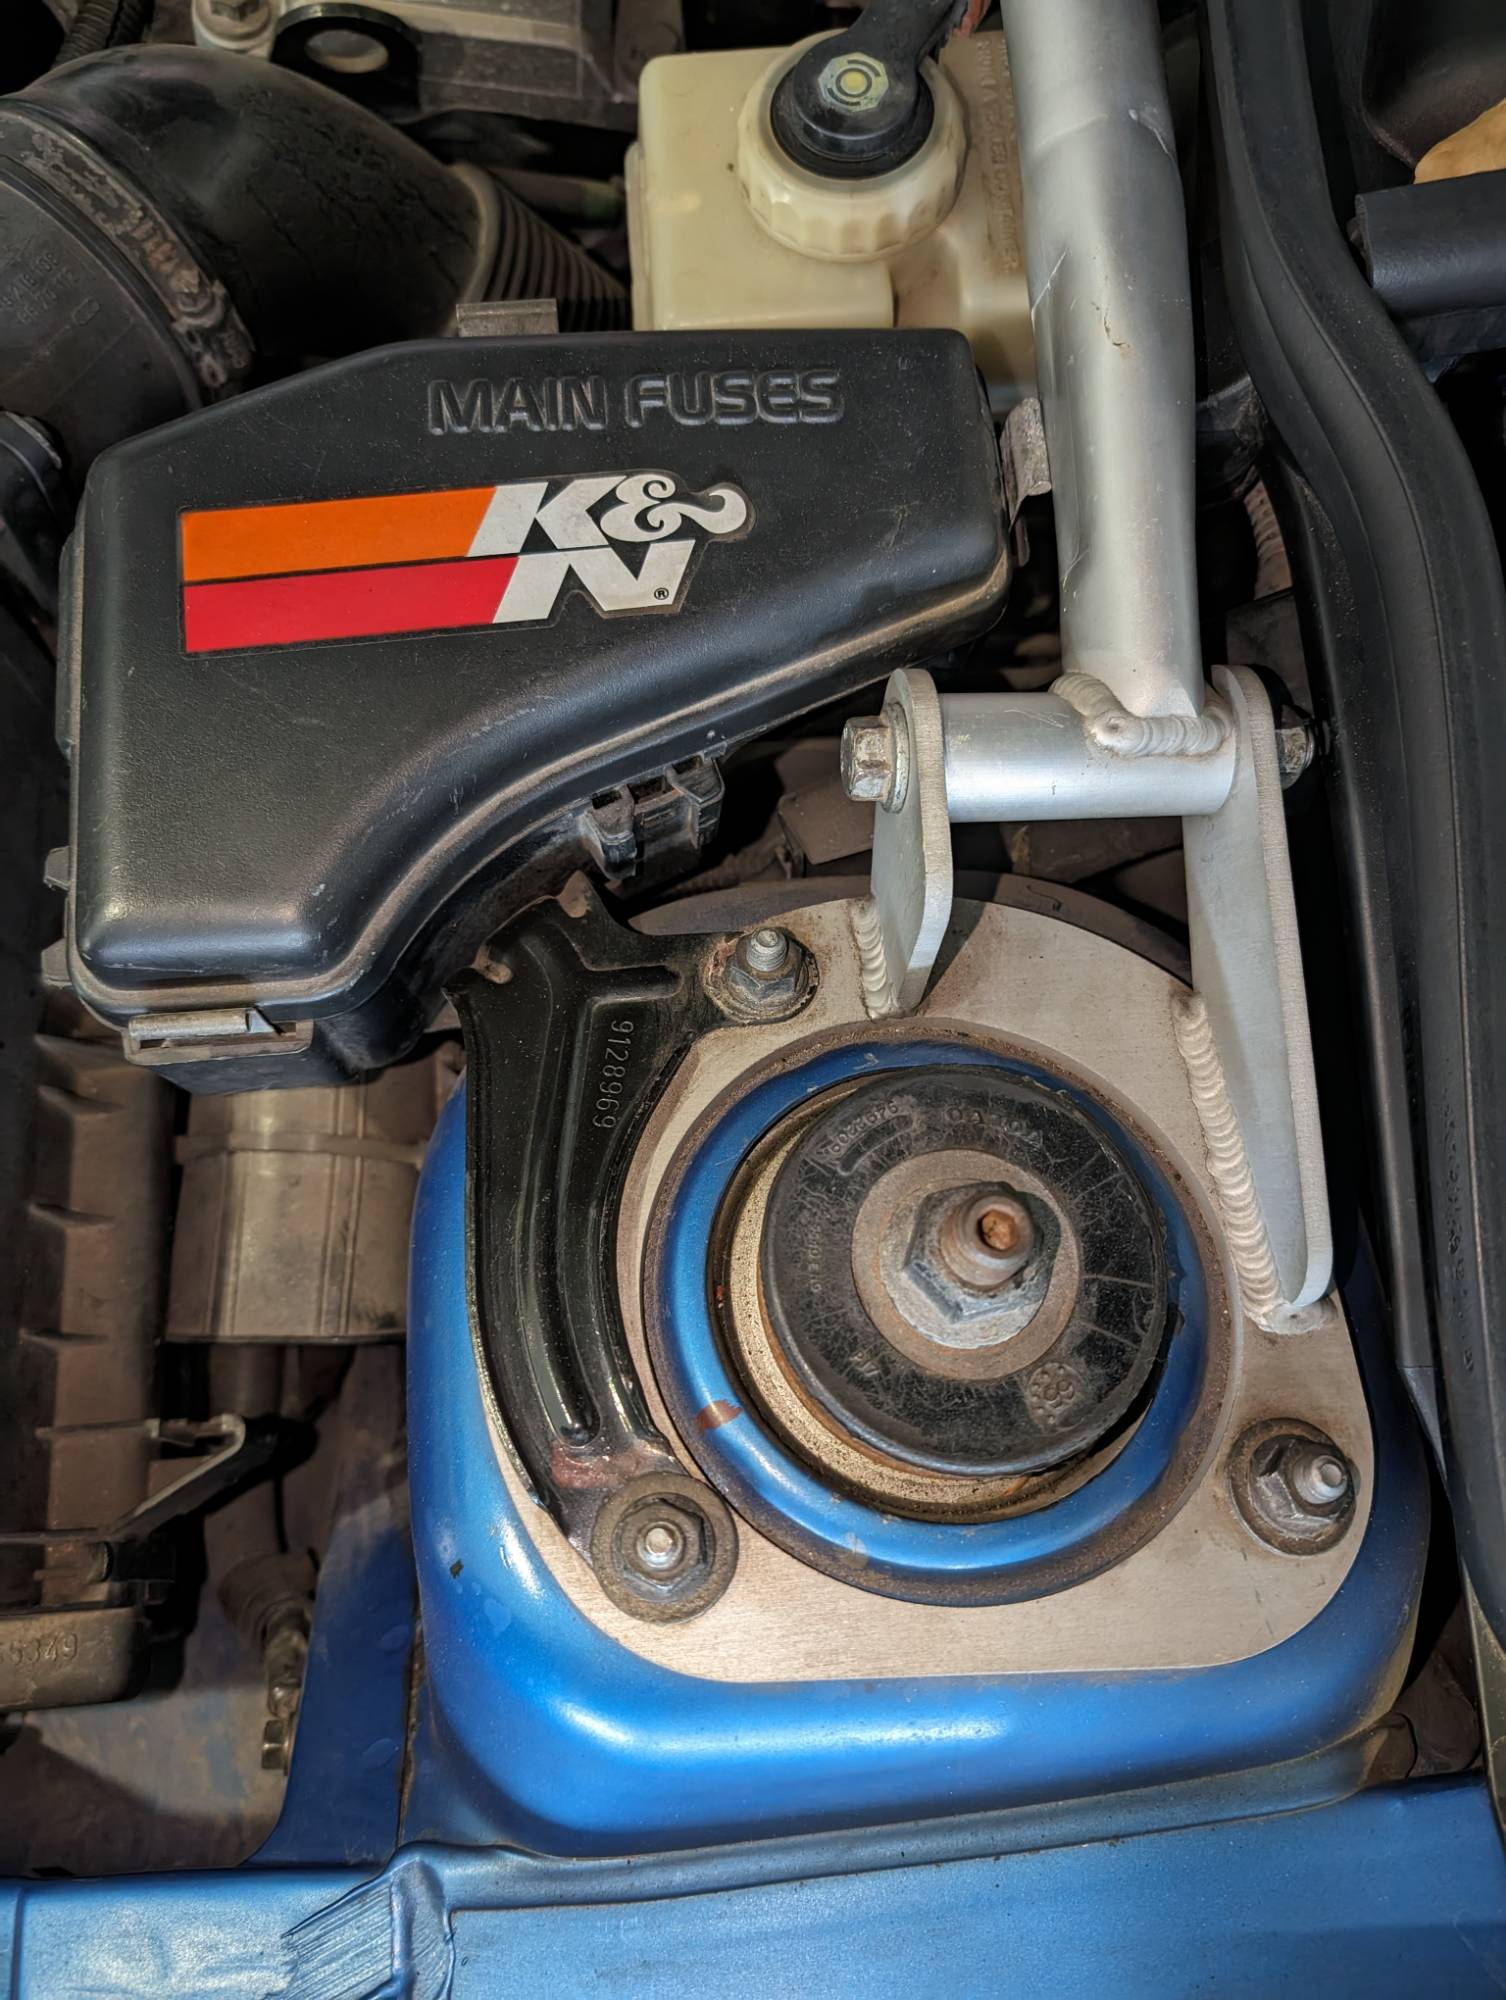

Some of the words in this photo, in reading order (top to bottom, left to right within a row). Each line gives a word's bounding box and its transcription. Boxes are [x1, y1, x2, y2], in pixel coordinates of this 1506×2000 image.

[428, 372, 609, 436] MAIN
[623, 368, 846, 428] FUSES
[592, 1020, 635, 1128] 9128969
